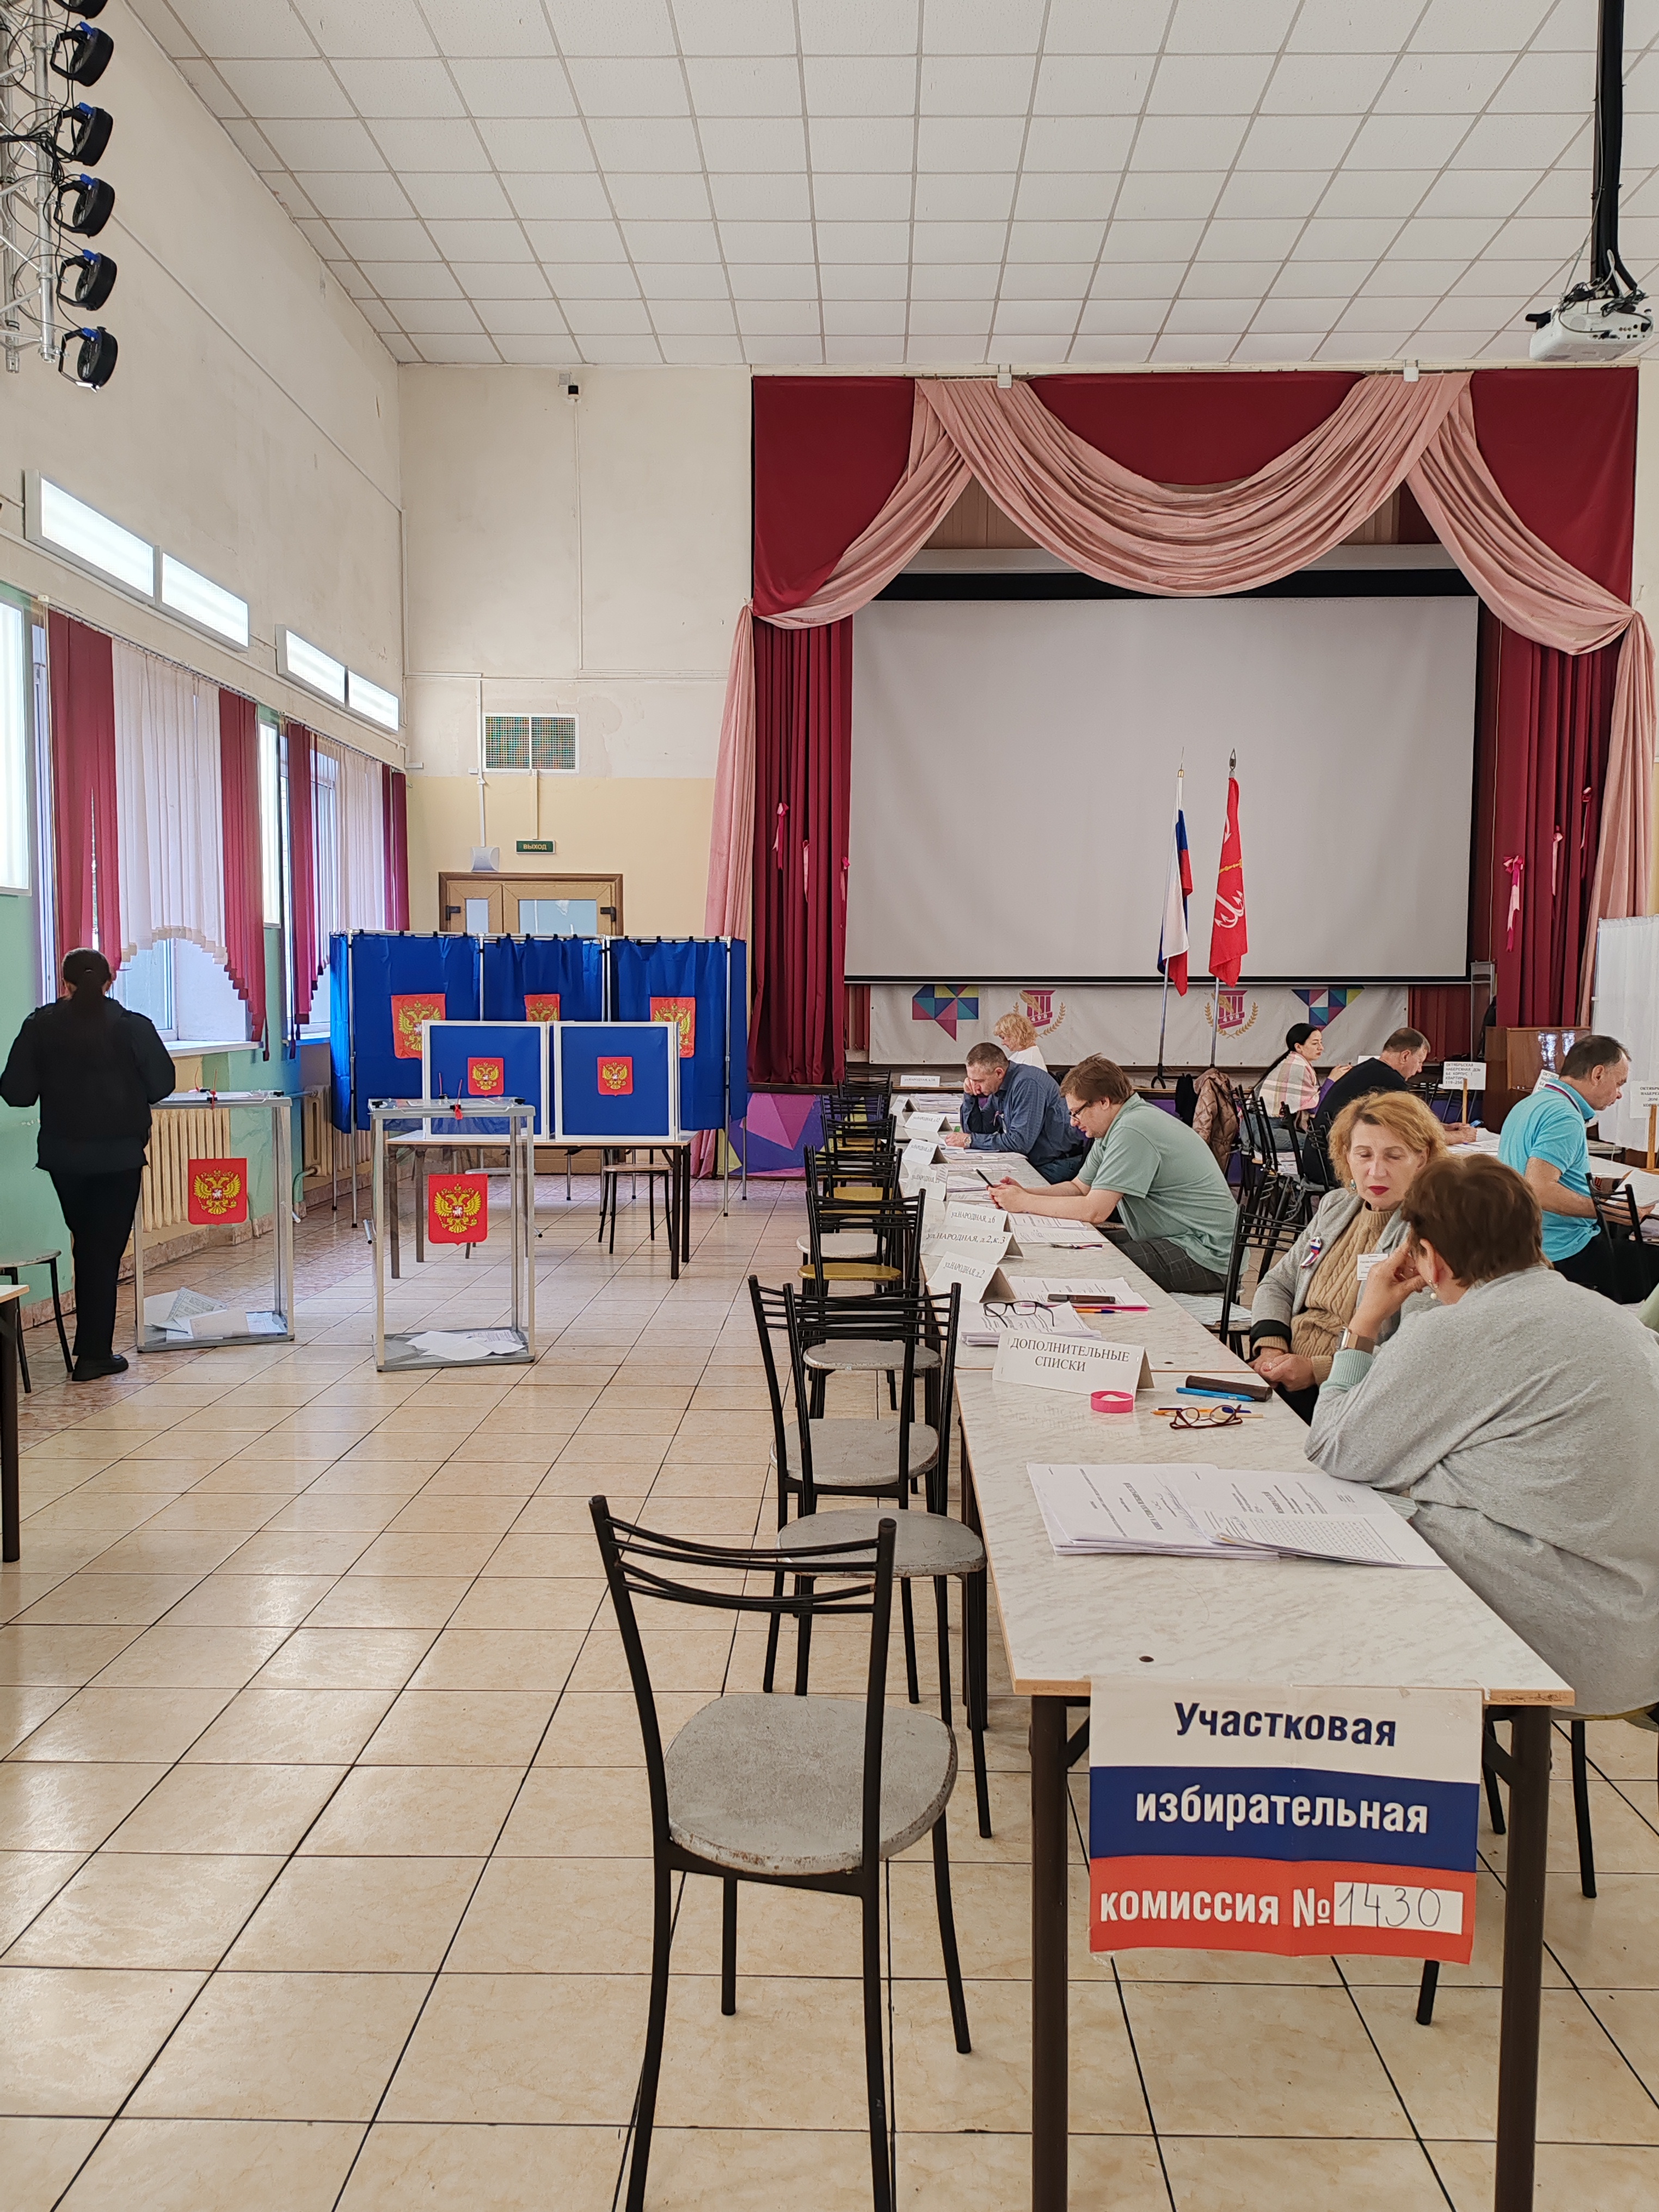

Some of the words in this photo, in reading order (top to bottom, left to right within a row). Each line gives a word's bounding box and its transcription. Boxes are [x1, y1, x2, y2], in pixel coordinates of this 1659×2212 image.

[1010, 1337, 1130, 1362] ДОПОЛНИТЕЛЬНЫЕ
[1035, 1355, 1086, 1372] СПИСКИ
[1173, 1701, 1397, 1747] Участковая
[1135, 1785, 1429, 1834] избирательная
[1099, 1890, 1279, 1926] комиссия
